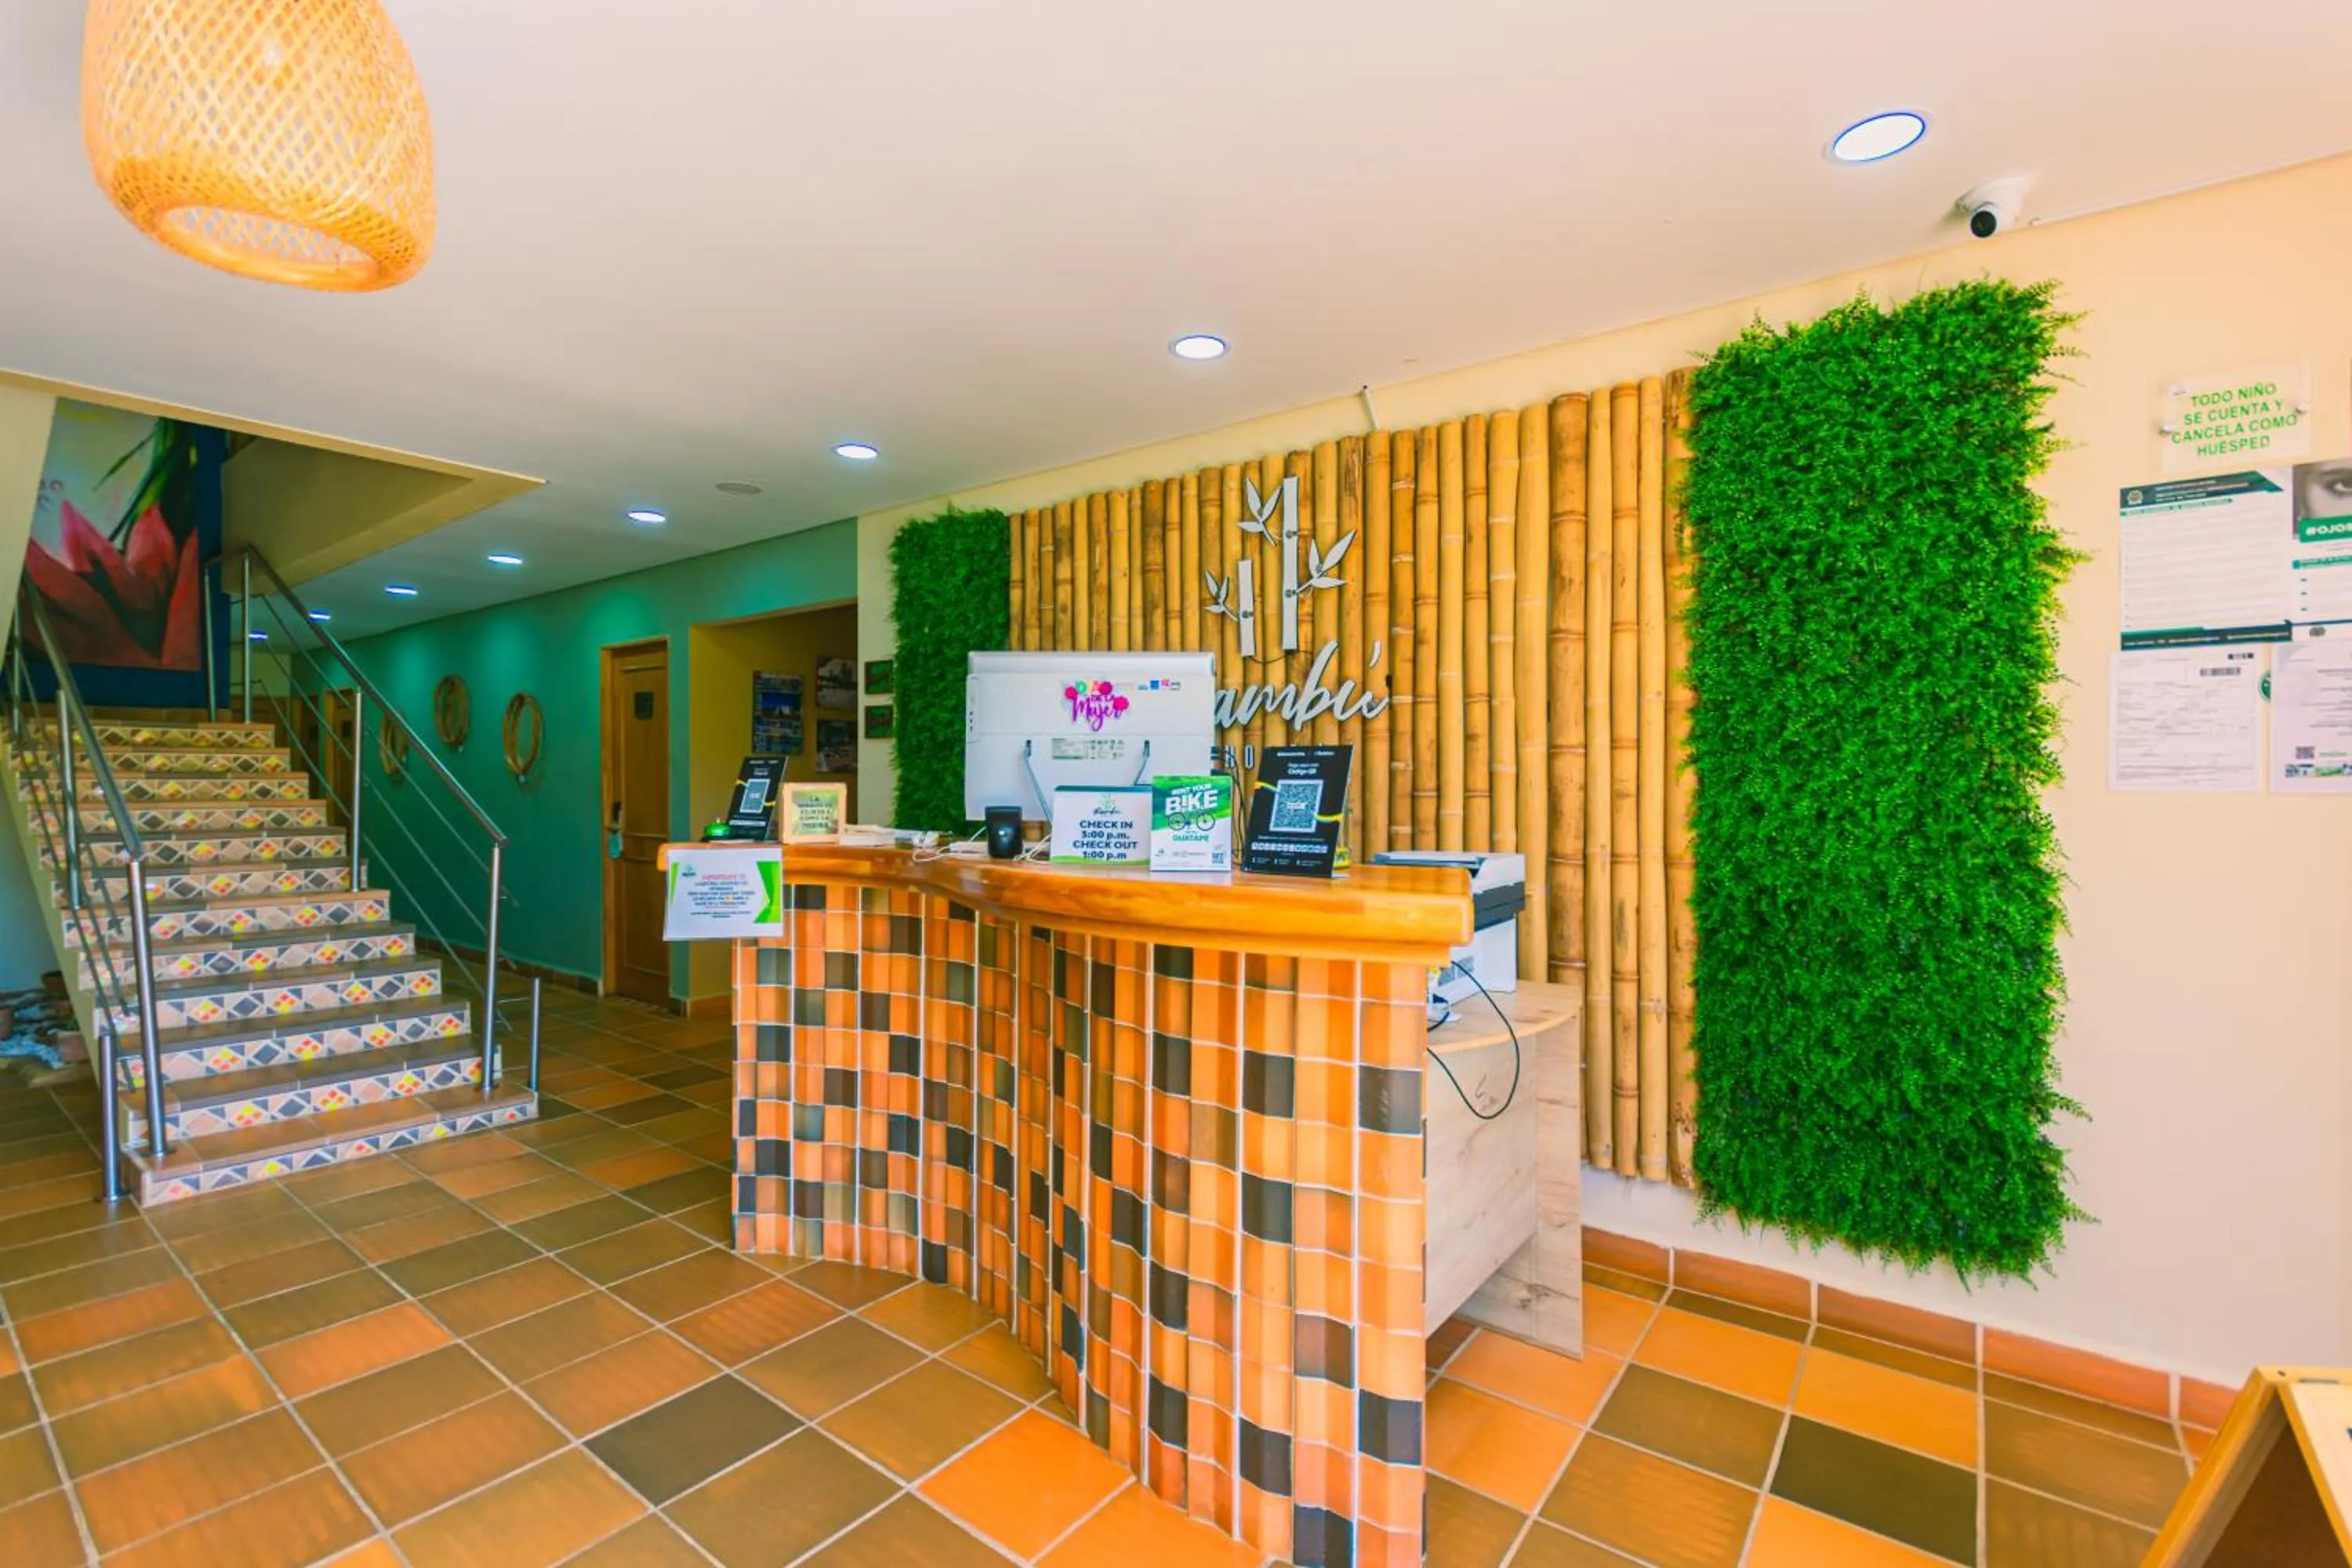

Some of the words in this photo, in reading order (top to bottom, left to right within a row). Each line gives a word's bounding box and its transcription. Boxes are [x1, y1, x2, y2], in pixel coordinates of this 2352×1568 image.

[2190, 390, 2233, 407] TODO
[2238, 382, 2277, 400] NIÑO
[2183, 412, 2202, 425] SE
[2208, 401, 2270, 421] CUENTA
[2274, 399, 2283, 412] Y
[2171, 423, 2245, 444] CANCELA
[2249, 413, 2298, 431] COMO
[1215, 639, 1391, 731] ambú
[1166, 789, 1218, 815] BIKE
[1079, 820, 1118, 829] CHECK
[1106, 832, 1130, 840] p.m.
[1073, 840, 1111, 849] CHECK
